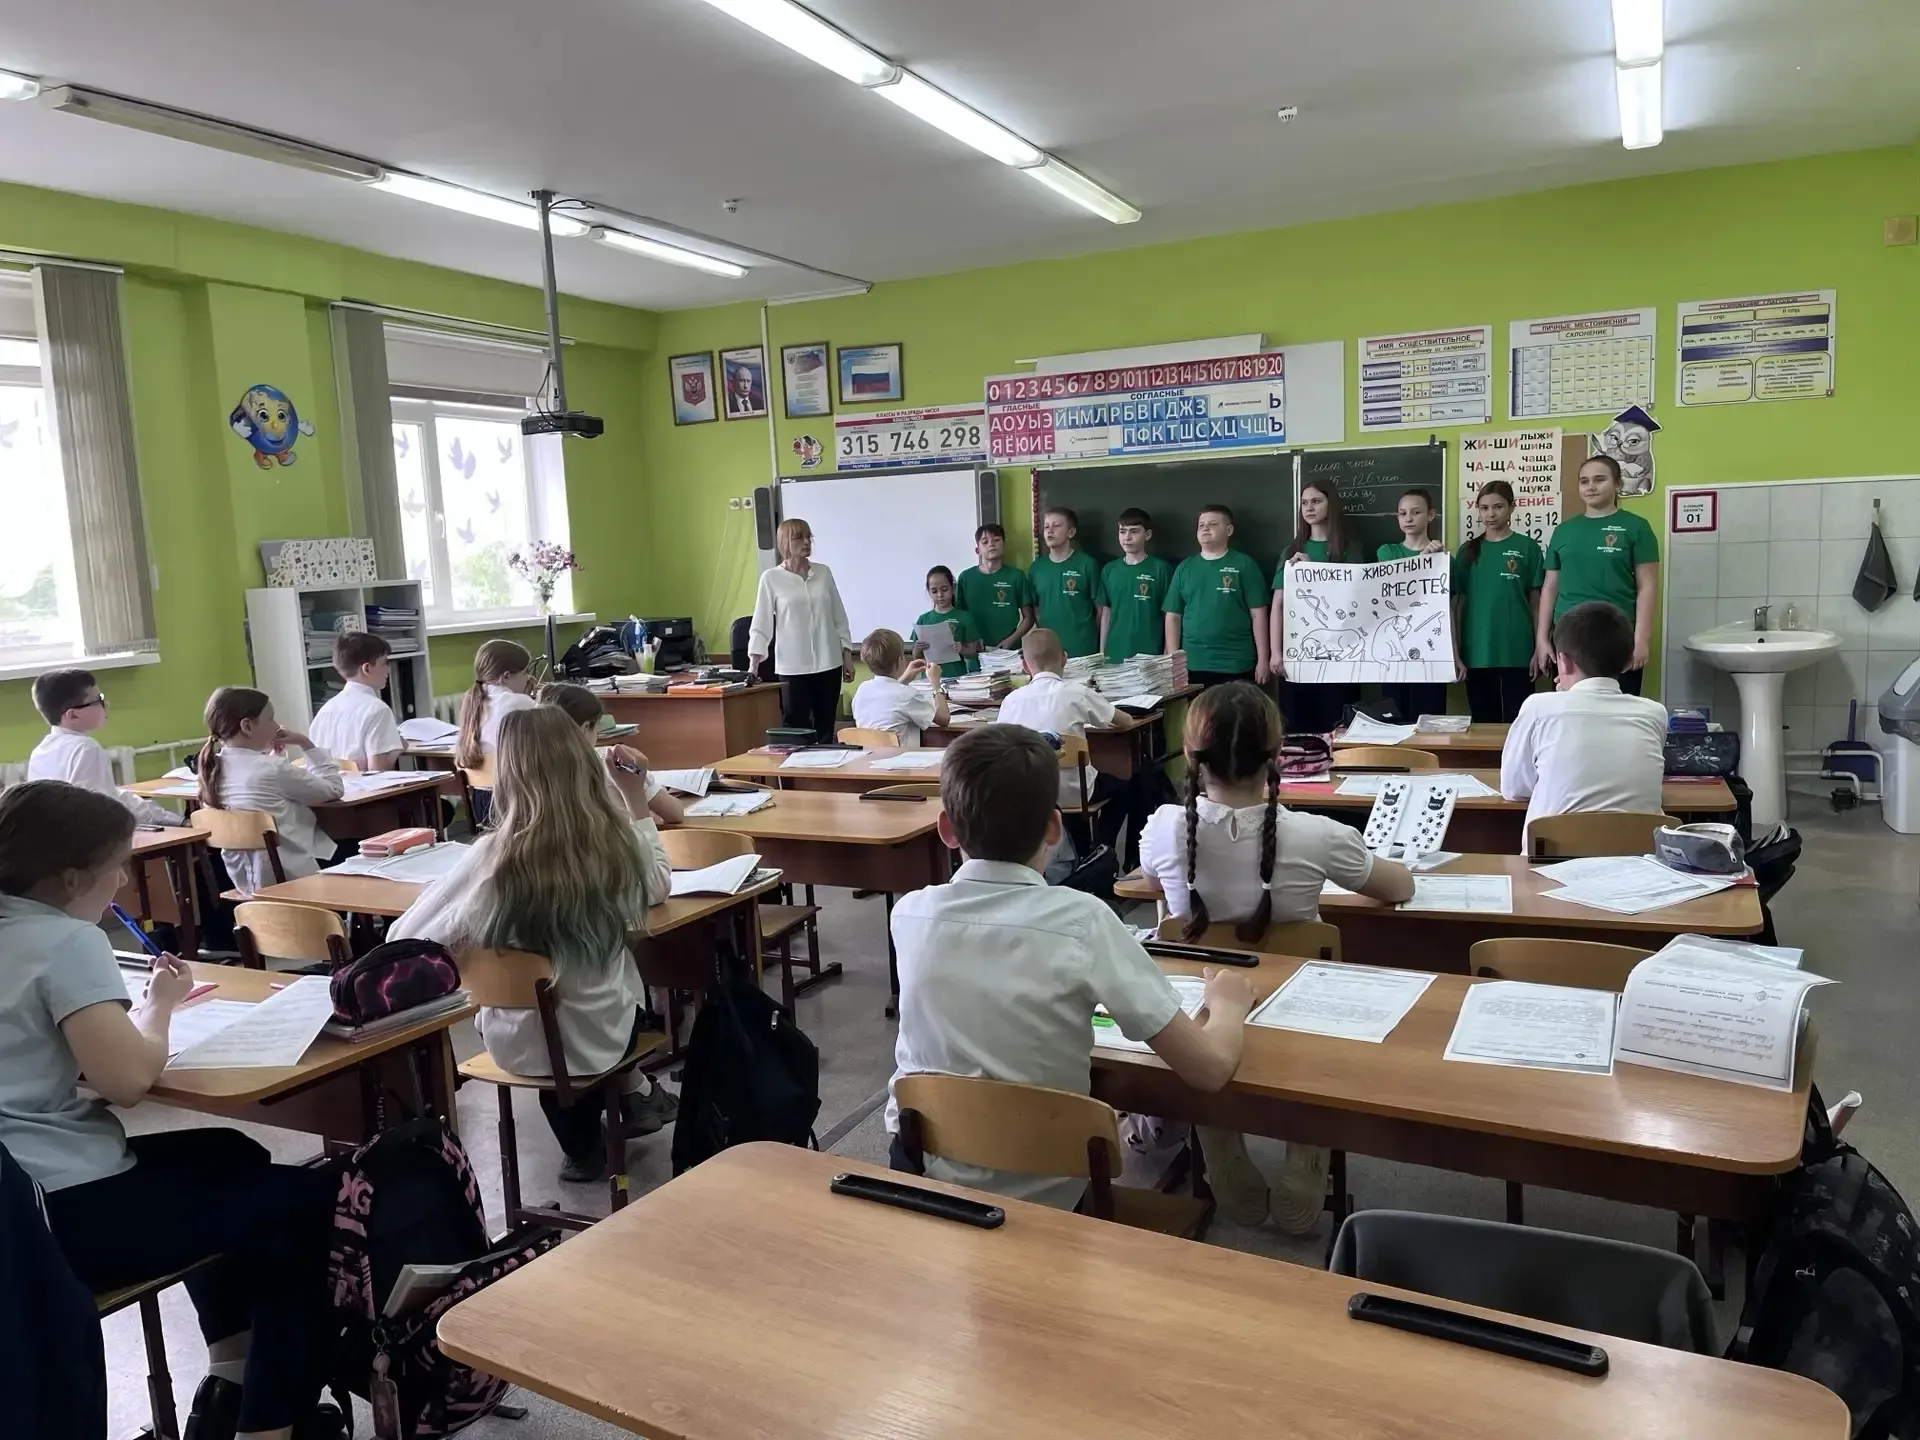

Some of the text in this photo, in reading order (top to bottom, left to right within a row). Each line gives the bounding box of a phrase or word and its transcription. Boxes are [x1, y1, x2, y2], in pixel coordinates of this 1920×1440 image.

[1566, 329, 1607, 338] СКЛОНЕНИЕ
[1378, 335, 1471, 350] ИМЯ СУЩЕСТВИТЕЛЬНОЕ
[1130, 390, 1184, 400] СОГЛАСНЫЕ
[1002, 402, 1041, 412] ГЛАСНЫЕ
[842, 434, 879, 456] 315
[890, 430, 930, 452] 746
[940, 426, 981, 448] 298
[1520, 432, 1554, 440] лыжи
[1464, 438, 1519, 450] ЖИ-ШИ
[1520, 442, 1553, 450] шина
[1522, 454, 1554, 462] чаща
[1466, 460, 1516, 472] ЧА-ЩА
[1518, 464, 1556, 472] чашка
[1518, 475, 1552, 484] чулок
[1520, 484, 1550, 494] щука
[1546, 512, 1558, 526] 12
[1686, 514, 1700, 524] 01
[1295, 557, 1432, 583] ПОМОЖЕМ ЖИВОТНЫМ
[1382, 572, 1450, 598] ВМЕСТЕ!
